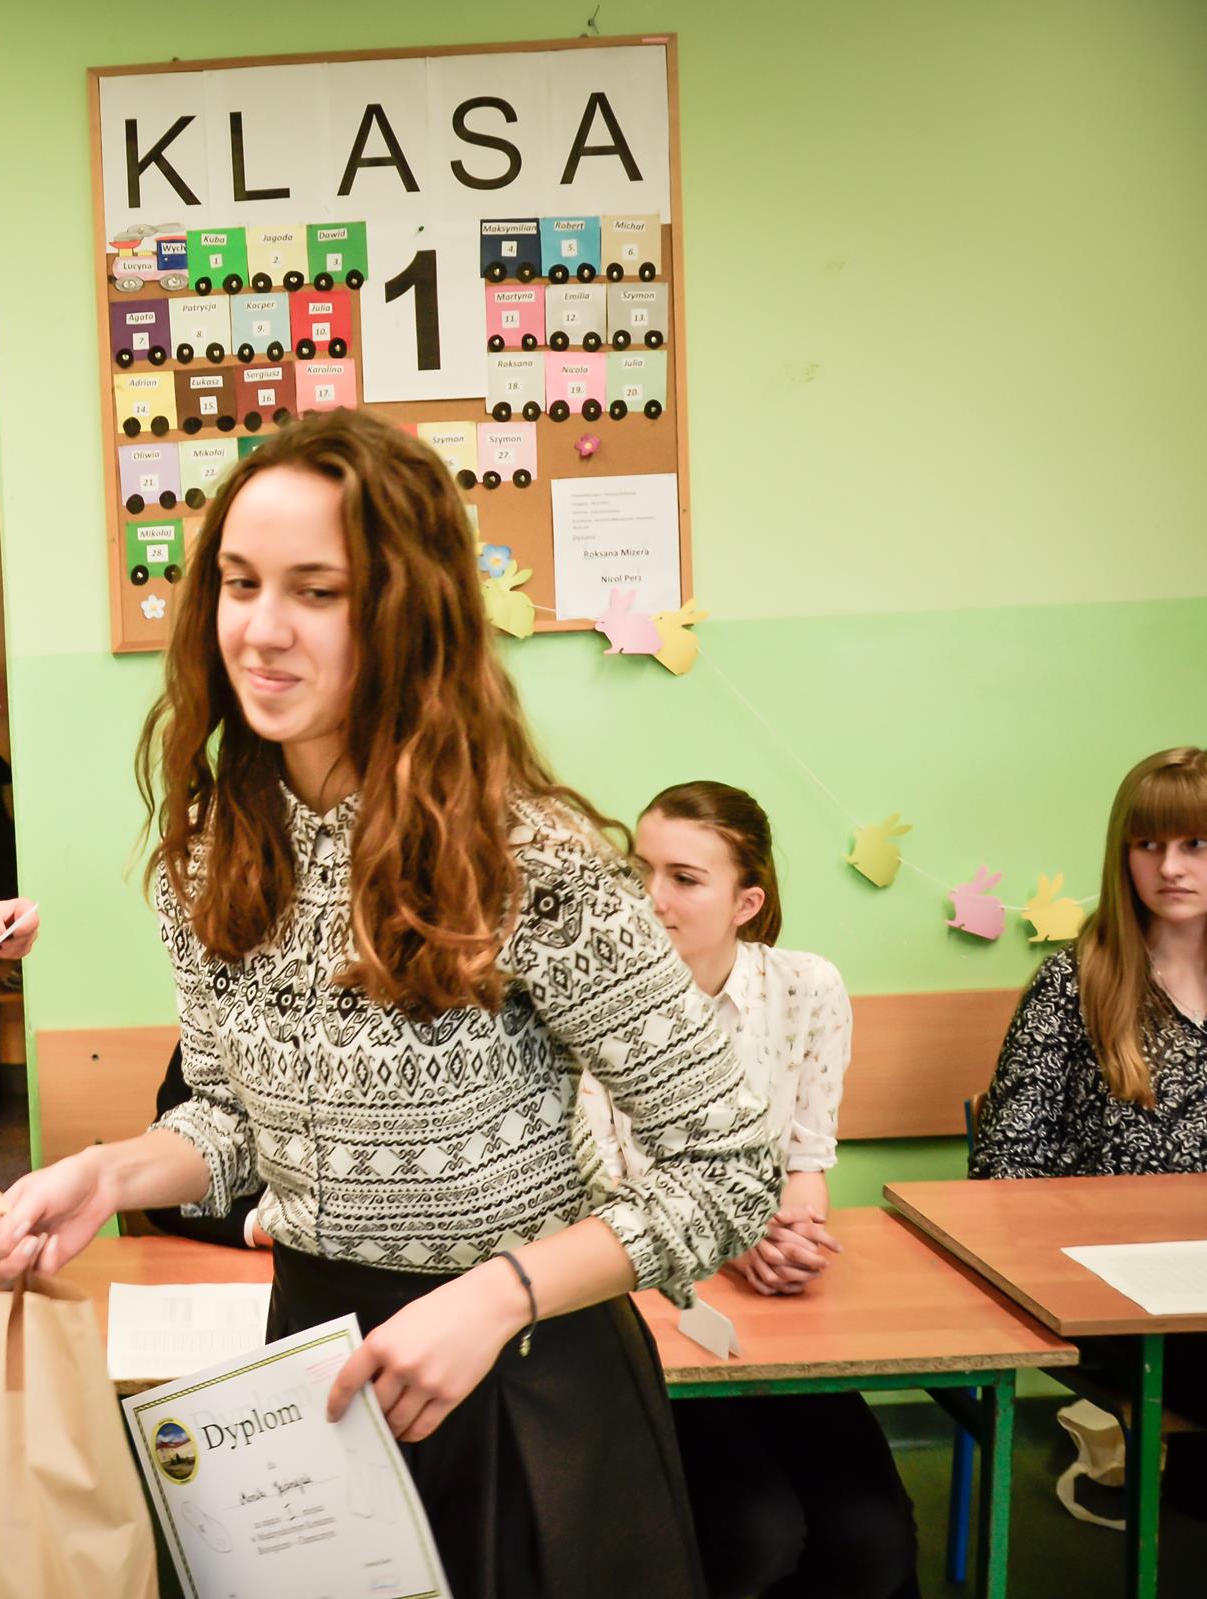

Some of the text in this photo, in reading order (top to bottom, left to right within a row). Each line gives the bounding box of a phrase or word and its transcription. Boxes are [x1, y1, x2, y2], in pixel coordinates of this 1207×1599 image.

[123, 91, 645, 210] KLASA
[483, 225, 537, 234] Maksymilian
[555, 221, 584, 230] Robert
[203, 235, 225, 243] Kuba
[263, 234, 293, 243] Jagoda
[319, 230, 346, 240] Dawid
[123, 262, 152, 271] Lucyna
[497, 292, 533, 302] Martyna
[622, 292, 655, 301] Szymon
[182, 303, 217, 313] Patrycja
[246, 302, 275, 311] Kacper
[311, 304, 331, 313] Julia
[384, 249, 441, 371] 1
[128, 312, 154, 322] Agata
[497, 360, 533, 368] Roksana
[623, 359, 643, 368] Julia
[307, 365, 343, 374] Karolina
[246, 369, 280, 380] Sergiusz
[128, 379, 157, 387] Adrian
[432, 436, 465, 445] Szymon
[489, 435, 522, 445] Szymon
[133, 451, 160, 460] Oliwia
[584, 550, 619, 559] Roksana
[201, 1404, 303, 1451] Dyplom
